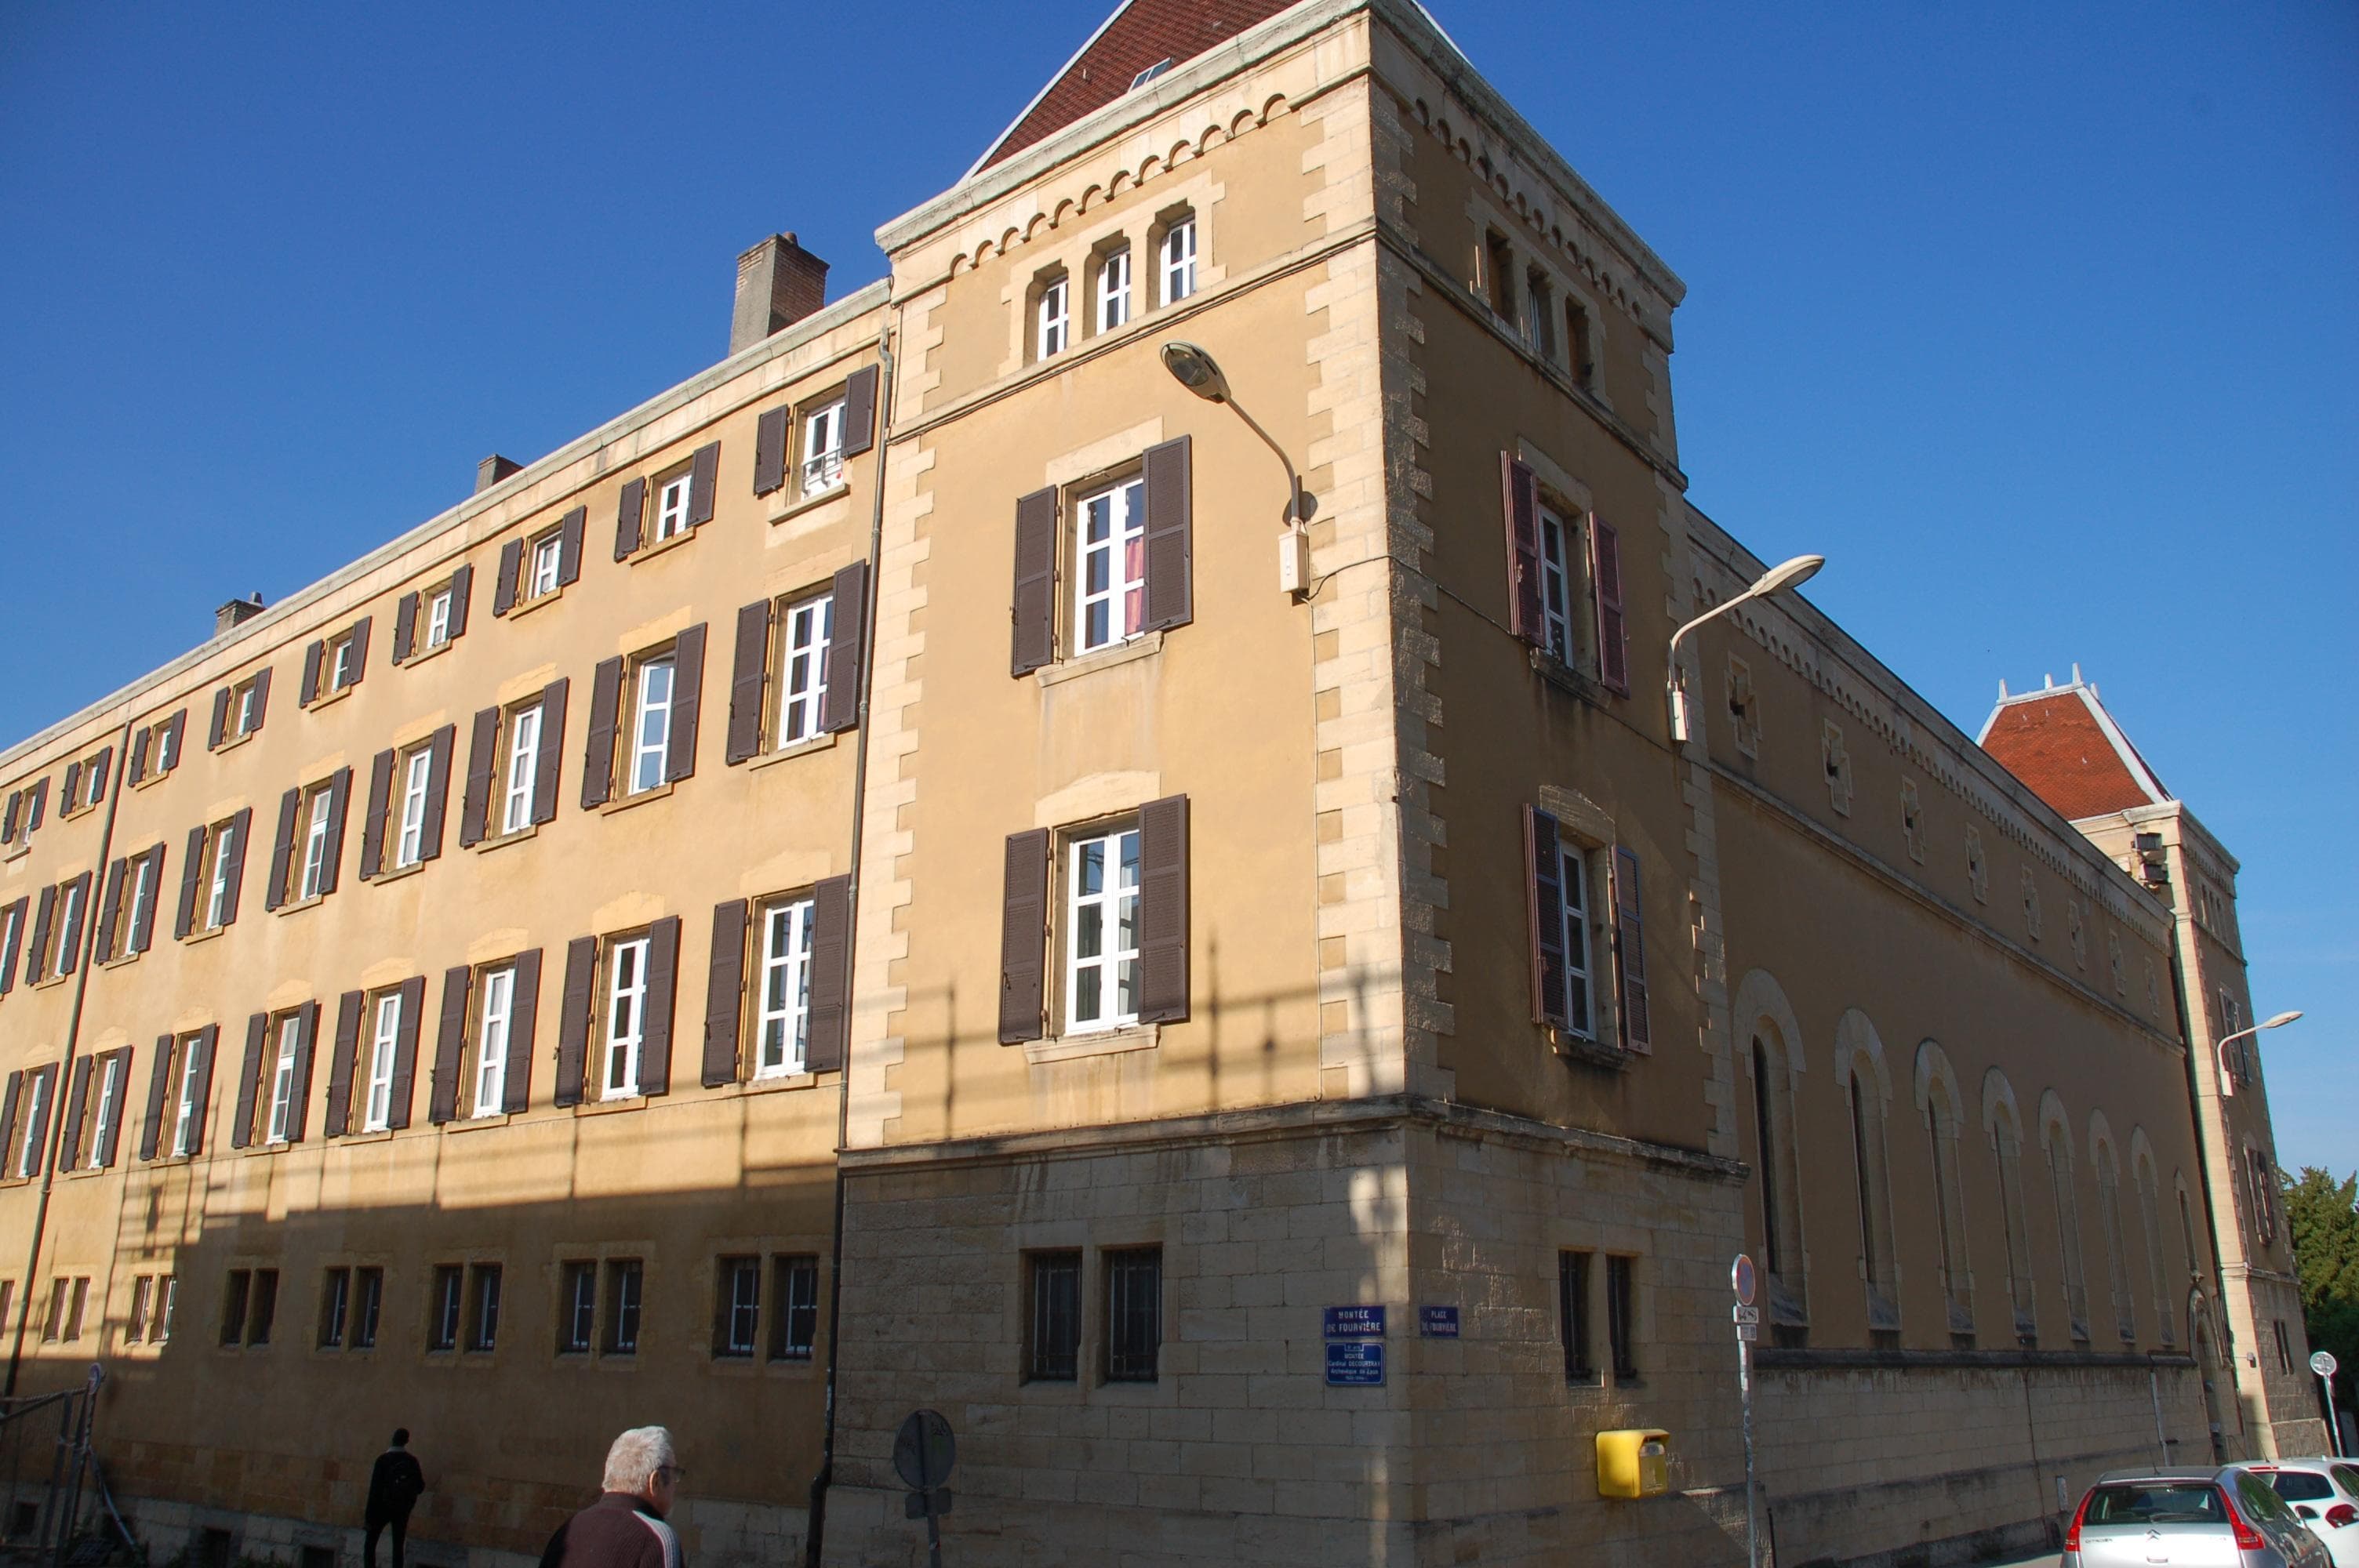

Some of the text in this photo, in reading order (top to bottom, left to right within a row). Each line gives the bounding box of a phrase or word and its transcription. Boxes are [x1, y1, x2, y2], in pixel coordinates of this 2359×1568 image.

[1338, 1308, 1369, 1319] MONTÉE
[1430, 1310, 1447, 1319] PLACE
[1326, 1321, 1381, 1333] DE FOURVIÈRE
